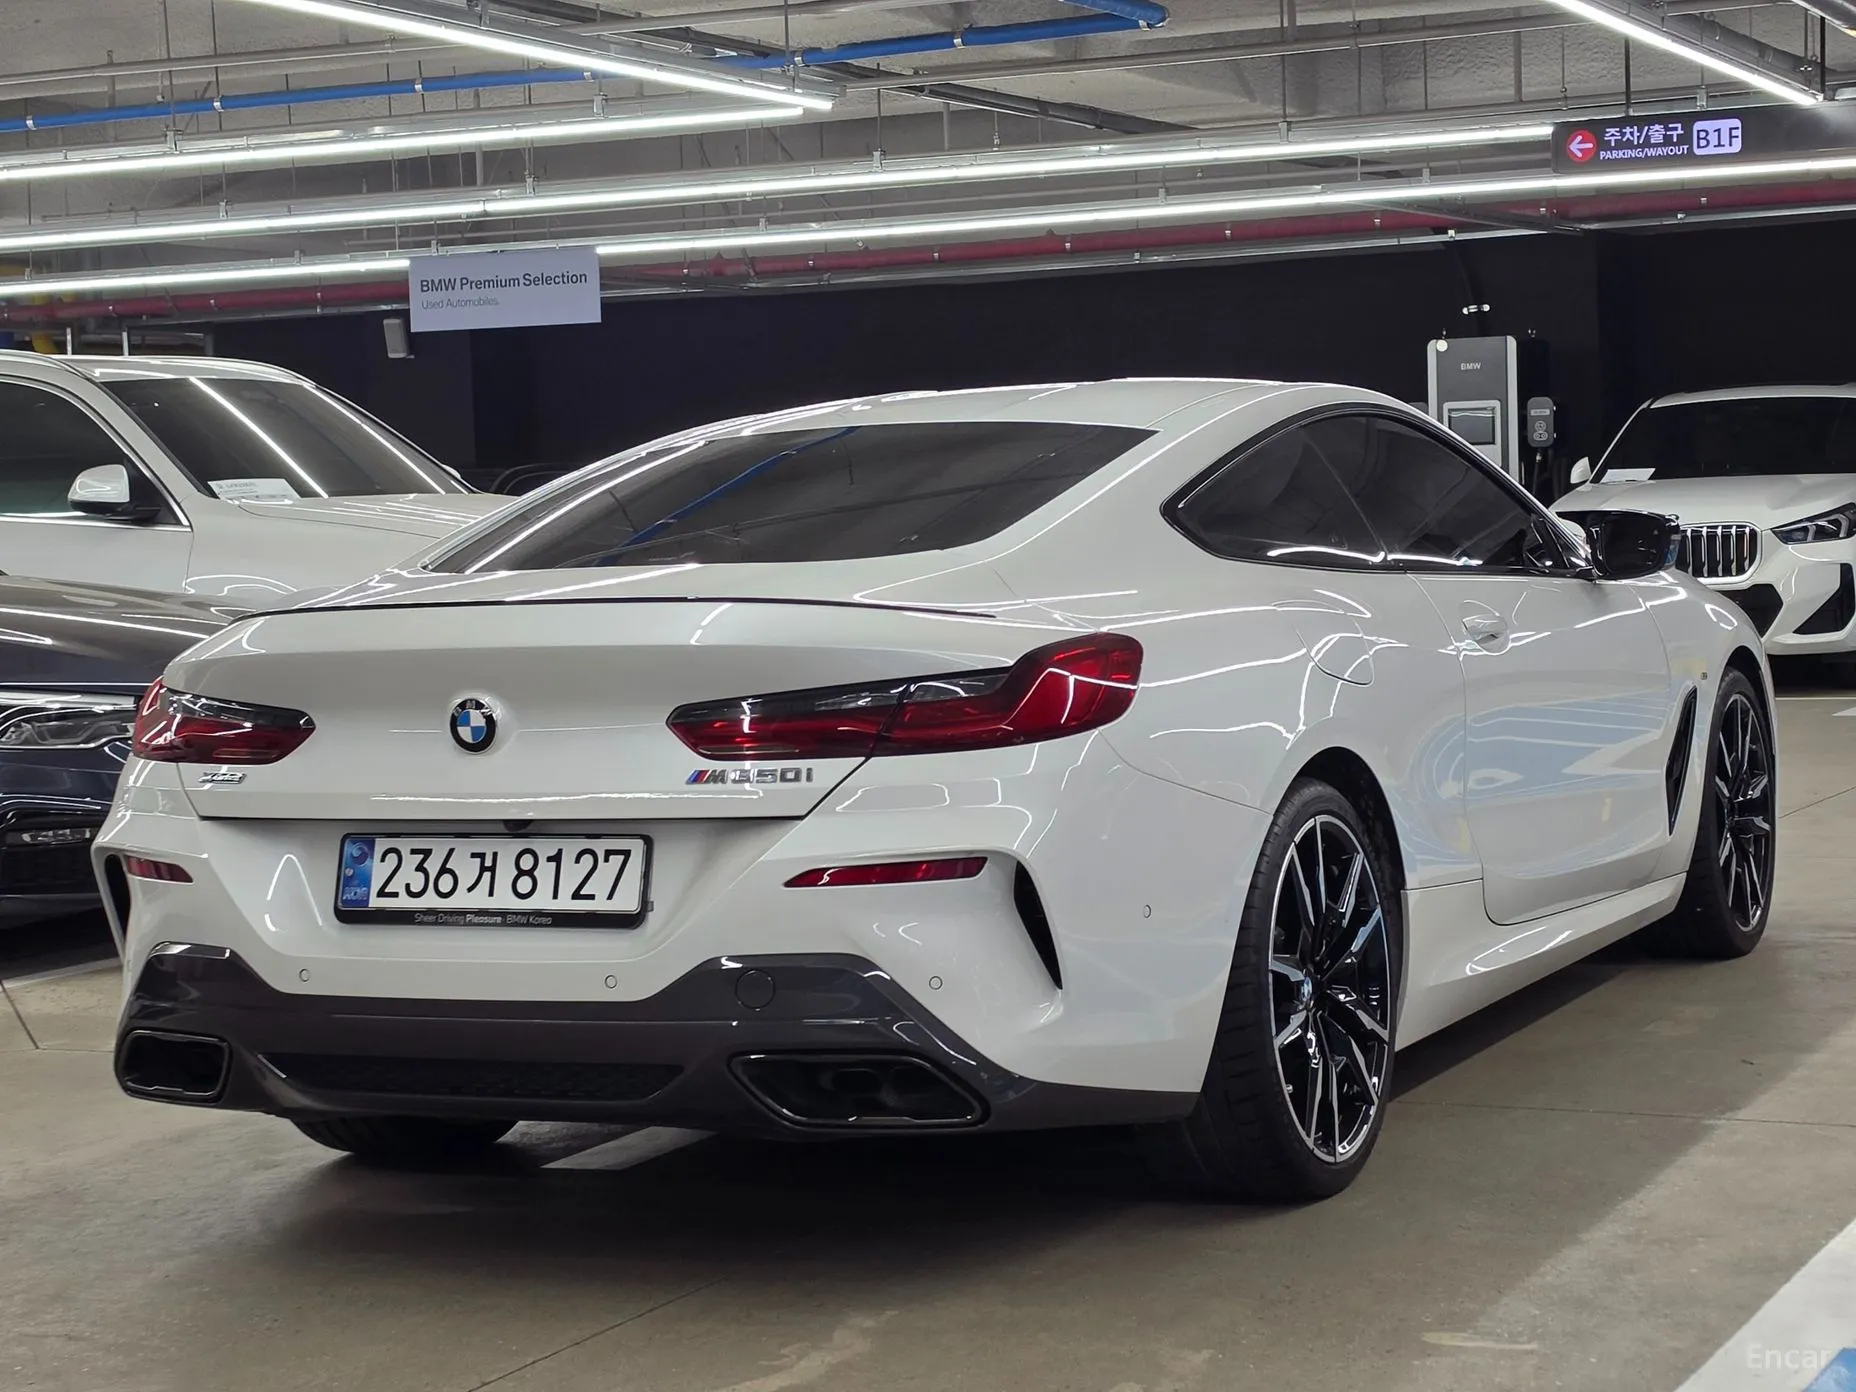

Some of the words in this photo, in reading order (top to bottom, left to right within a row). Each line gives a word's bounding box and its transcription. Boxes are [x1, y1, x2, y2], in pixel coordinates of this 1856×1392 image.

[1603, 123, 1684, 147] 주차/출구
[1696, 127, 1740, 149] B1F
[1600, 145, 1689, 160] PARKING/WAYOUT
[420, 278, 457, 293] BMW
[460, 275, 520, 291] Premium
[523, 271, 588, 286] Selection
[421, 298, 444, 310] Used
[1460, 362, 1482, 371] BMW
[376, 847, 499, 899] 236거
[511, 847, 632, 901] 8127
[414, 913, 437, 923] Sheer
[438, 913, 465, 925] Driving
[466, 914, 502, 924] Pleasure
[506, 914, 528, 924] BMW
[529, 914, 553, 925] Korea
